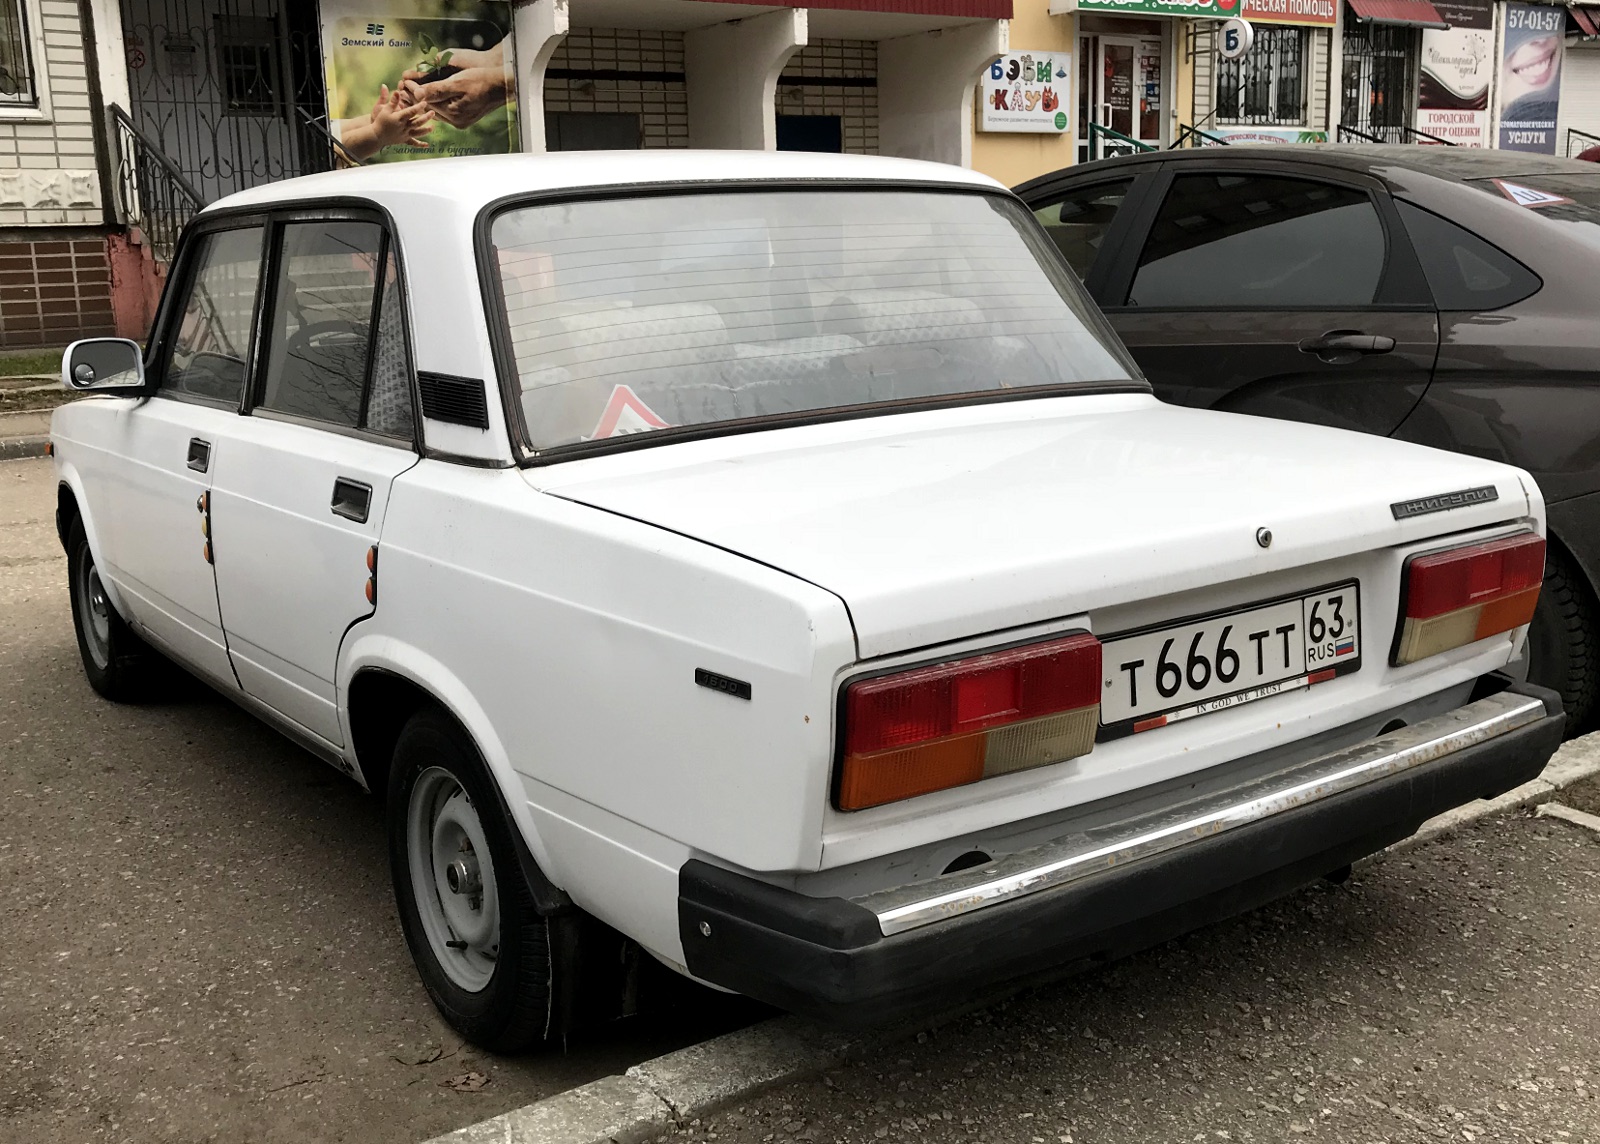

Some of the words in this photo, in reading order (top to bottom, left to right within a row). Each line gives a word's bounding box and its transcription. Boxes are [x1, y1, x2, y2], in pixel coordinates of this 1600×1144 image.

[1290, 0, 1334, 19] ПОМОЩЬ
[1509, 9, 1560, 31] 57-01-57
[341, 37, 384, 47] Земский
[389, 38, 411, 47] банк
[1226, 28, 1239, 51] Б
[991, 58, 1052, 84] БЭБИ
[990, 84, 1059, 112] КЛУБ
[1429, 112, 1475, 124] ГОРОДСКОЙ
[1421, 126, 1447, 136] ЦЕНТР
[1449, 127, 1481, 137] ОЦЕНКИ
[1508, 131, 1546, 144] УСЛУГИ
[1406, 489, 1489, 513] ЖИГУЛИ
[1309, 595, 1345, 643] 63
[1308, 643, 1335, 663] RUS
[1196, 704, 1207, 714] IN
[1211, 697, 1232, 710] GOD
[1236, 692, 1251, 702] WE
[1255, 684, 1283, 698] TRUST
